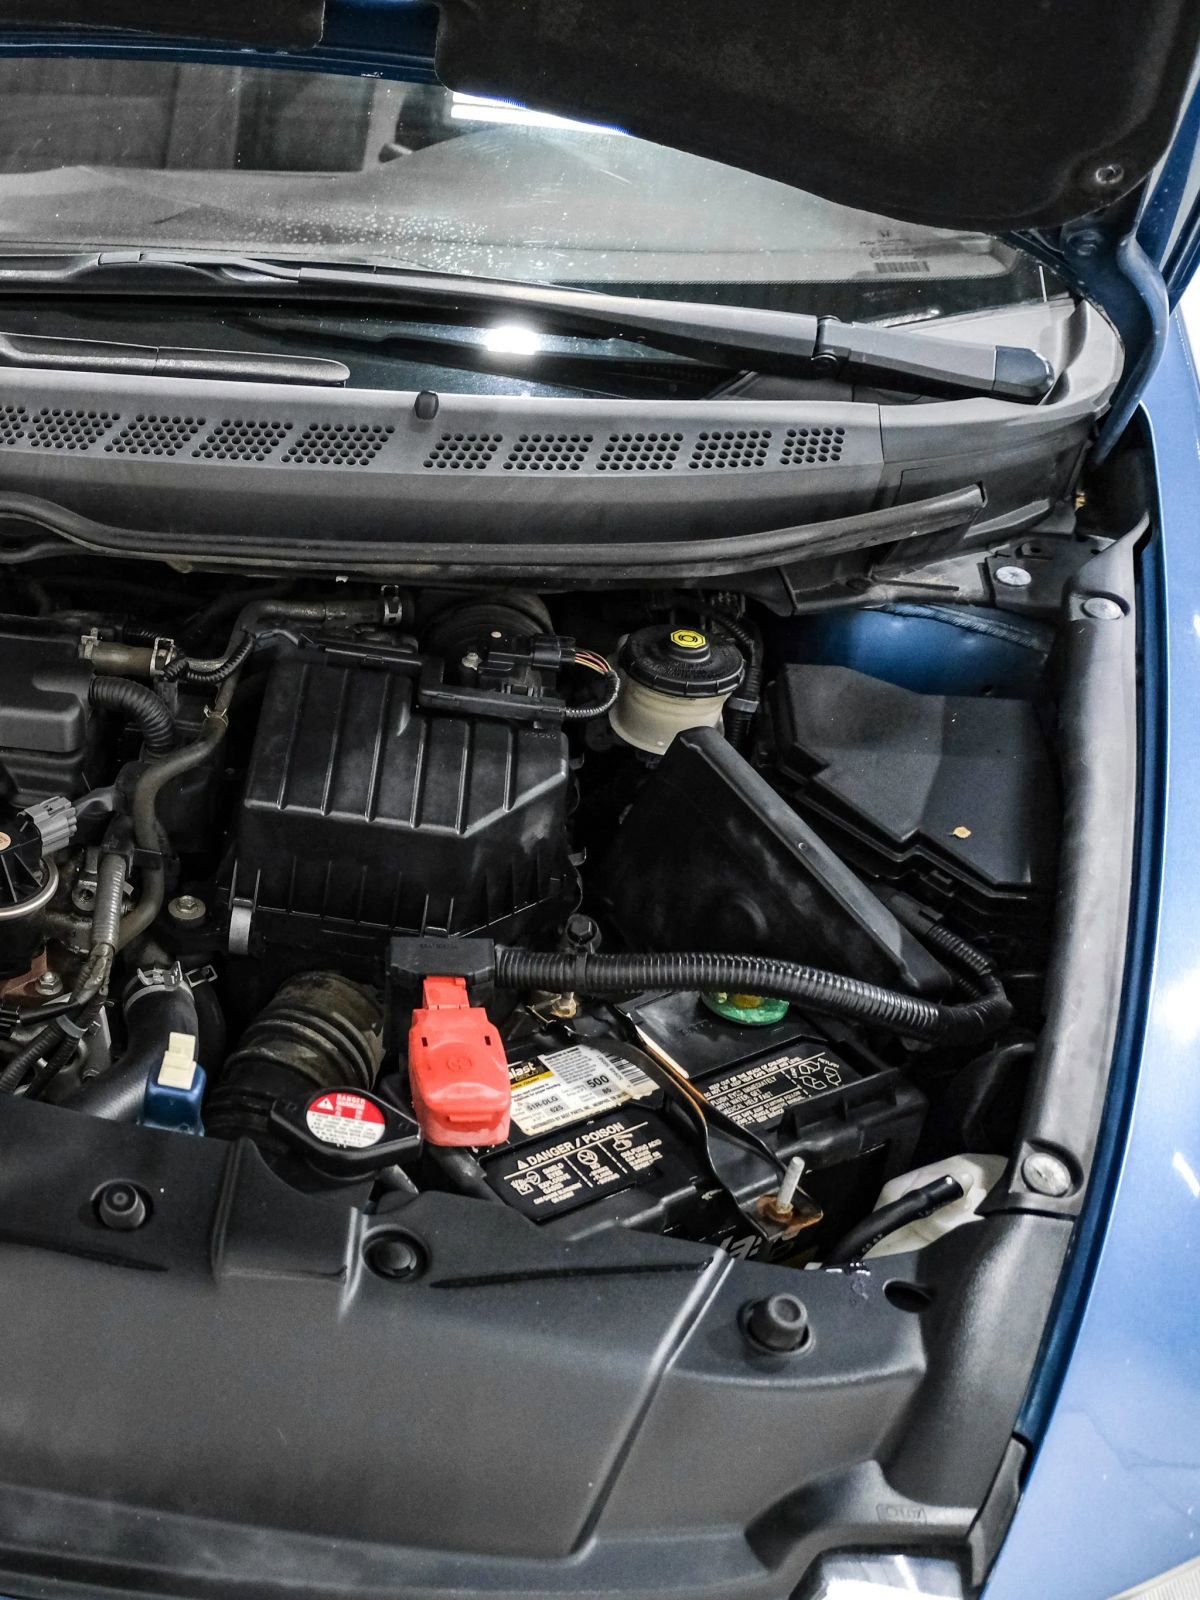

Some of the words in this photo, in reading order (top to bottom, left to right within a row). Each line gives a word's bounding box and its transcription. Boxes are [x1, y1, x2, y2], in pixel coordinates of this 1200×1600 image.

[818, 1058, 839, 1068] RETURN
[586, 1075, 609, 1088] 500
[710, 1095, 729, 1106] FLUSH
[741, 1076, 777, 1093] IMMEDIATELY
[743, 1097, 758, 1106] HELP
[758, 1091, 773, 1100] FAST
[715, 1101, 732, 1110] WITH
[749, 1088, 762, 1097] GET
[549, 1105, 564, 1113] 625
[526, 1140, 575, 1166] DANGER
[575, 1137, 581, 1148] /
[581, 1122, 625, 1144] POISON
[648, 1138, 662, 1148] ACID
[538, 1172, 571, 1189] EXPLOSIVE
